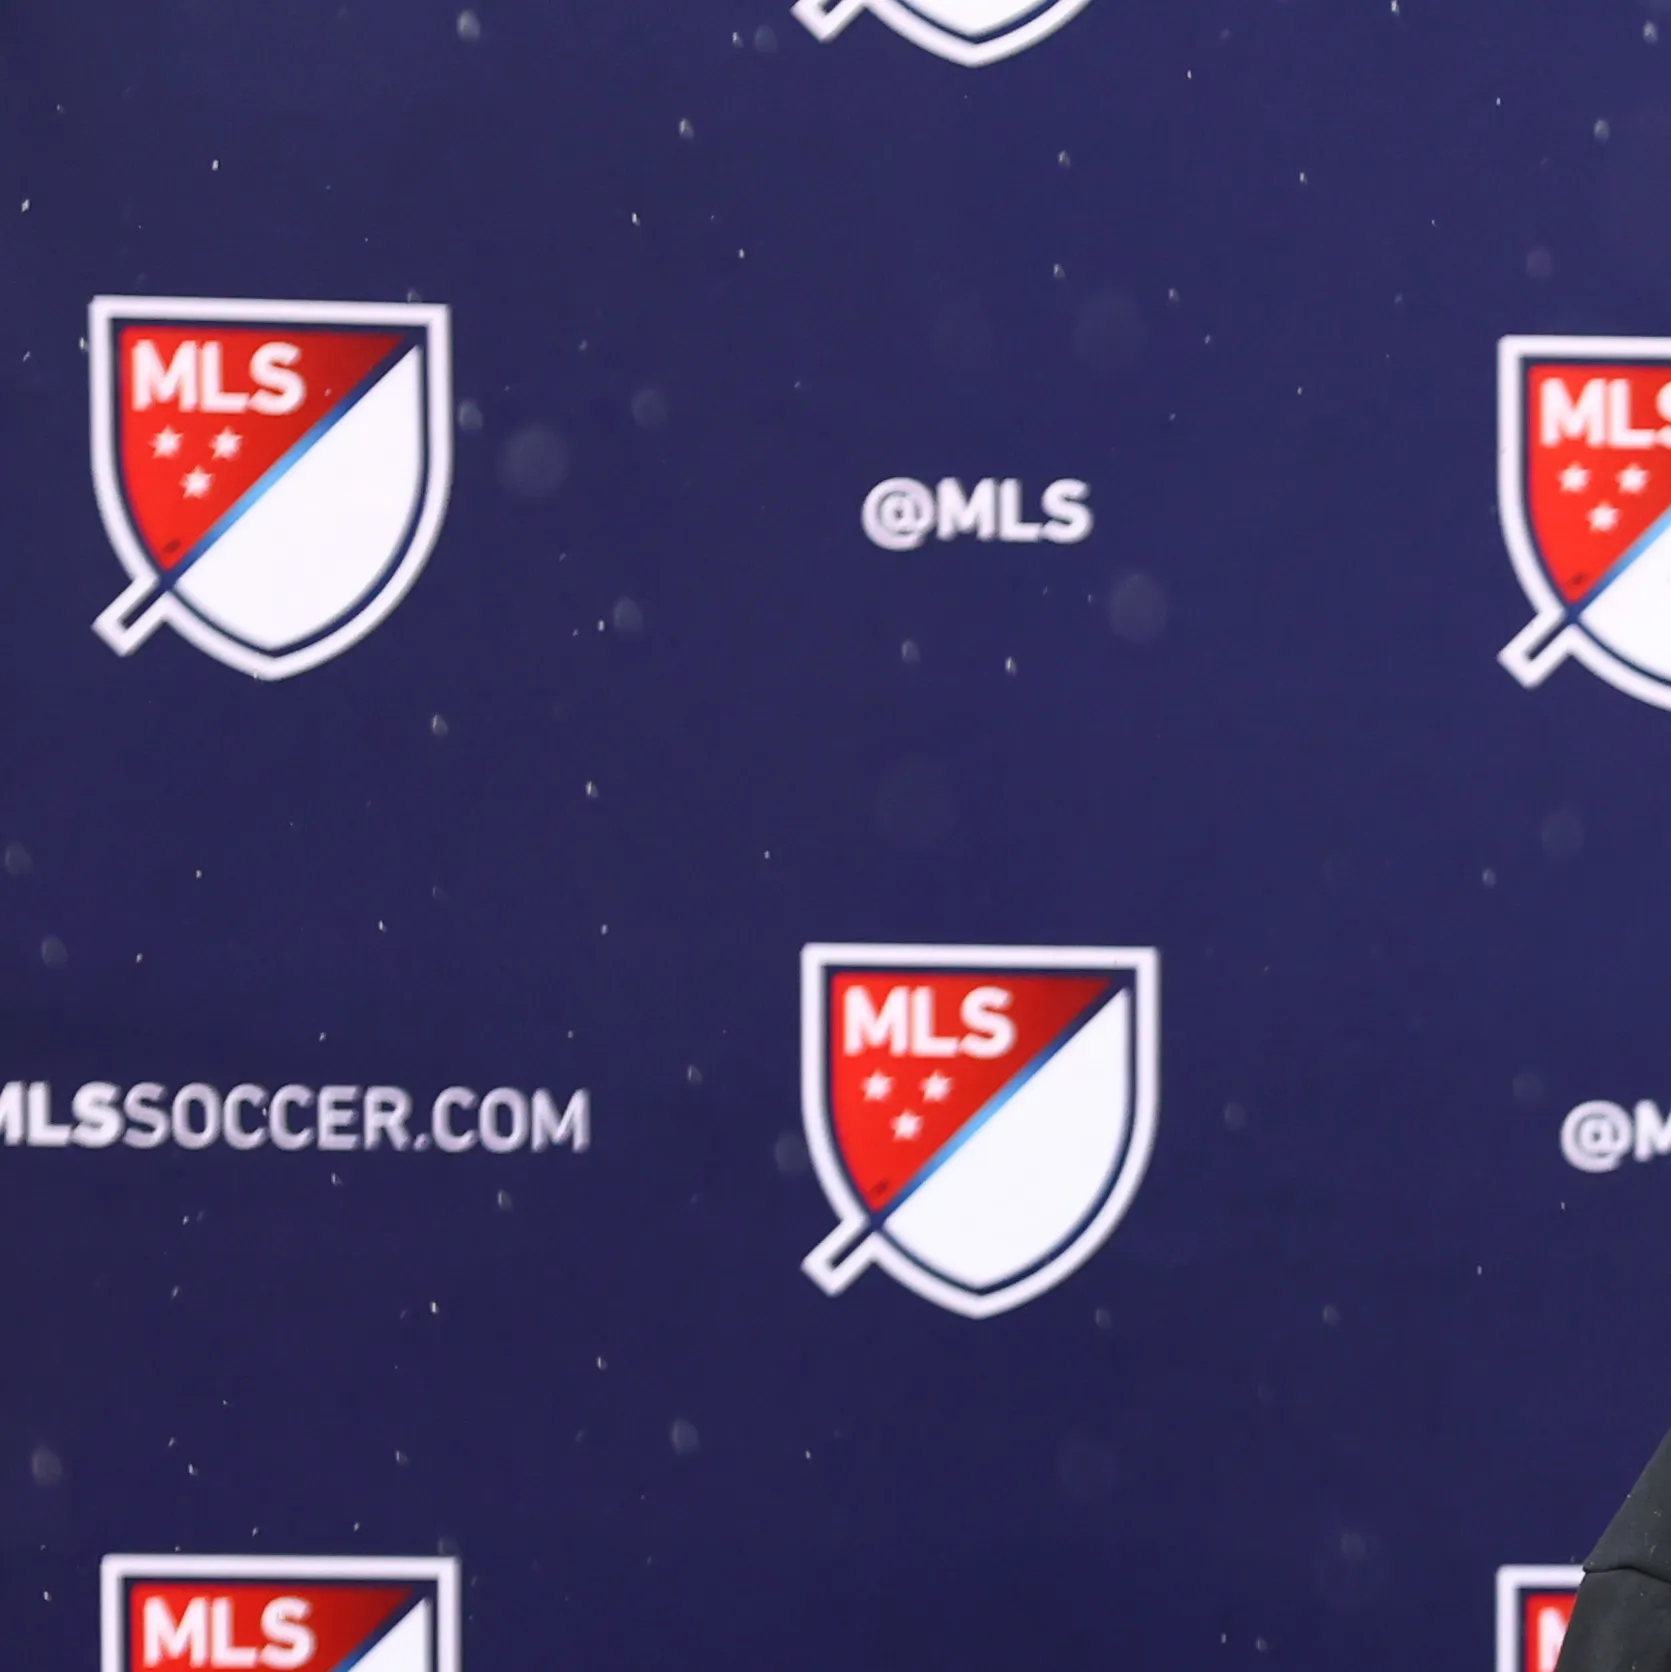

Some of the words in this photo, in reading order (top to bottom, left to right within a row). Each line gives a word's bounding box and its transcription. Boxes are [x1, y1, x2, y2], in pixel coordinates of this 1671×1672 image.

[130, 338, 307, 416] MLS
[860, 475, 1093, 552] @MLS
[842, 984, 1016, 1060] MLS
[142, 1595, 316, 1670] MLS
